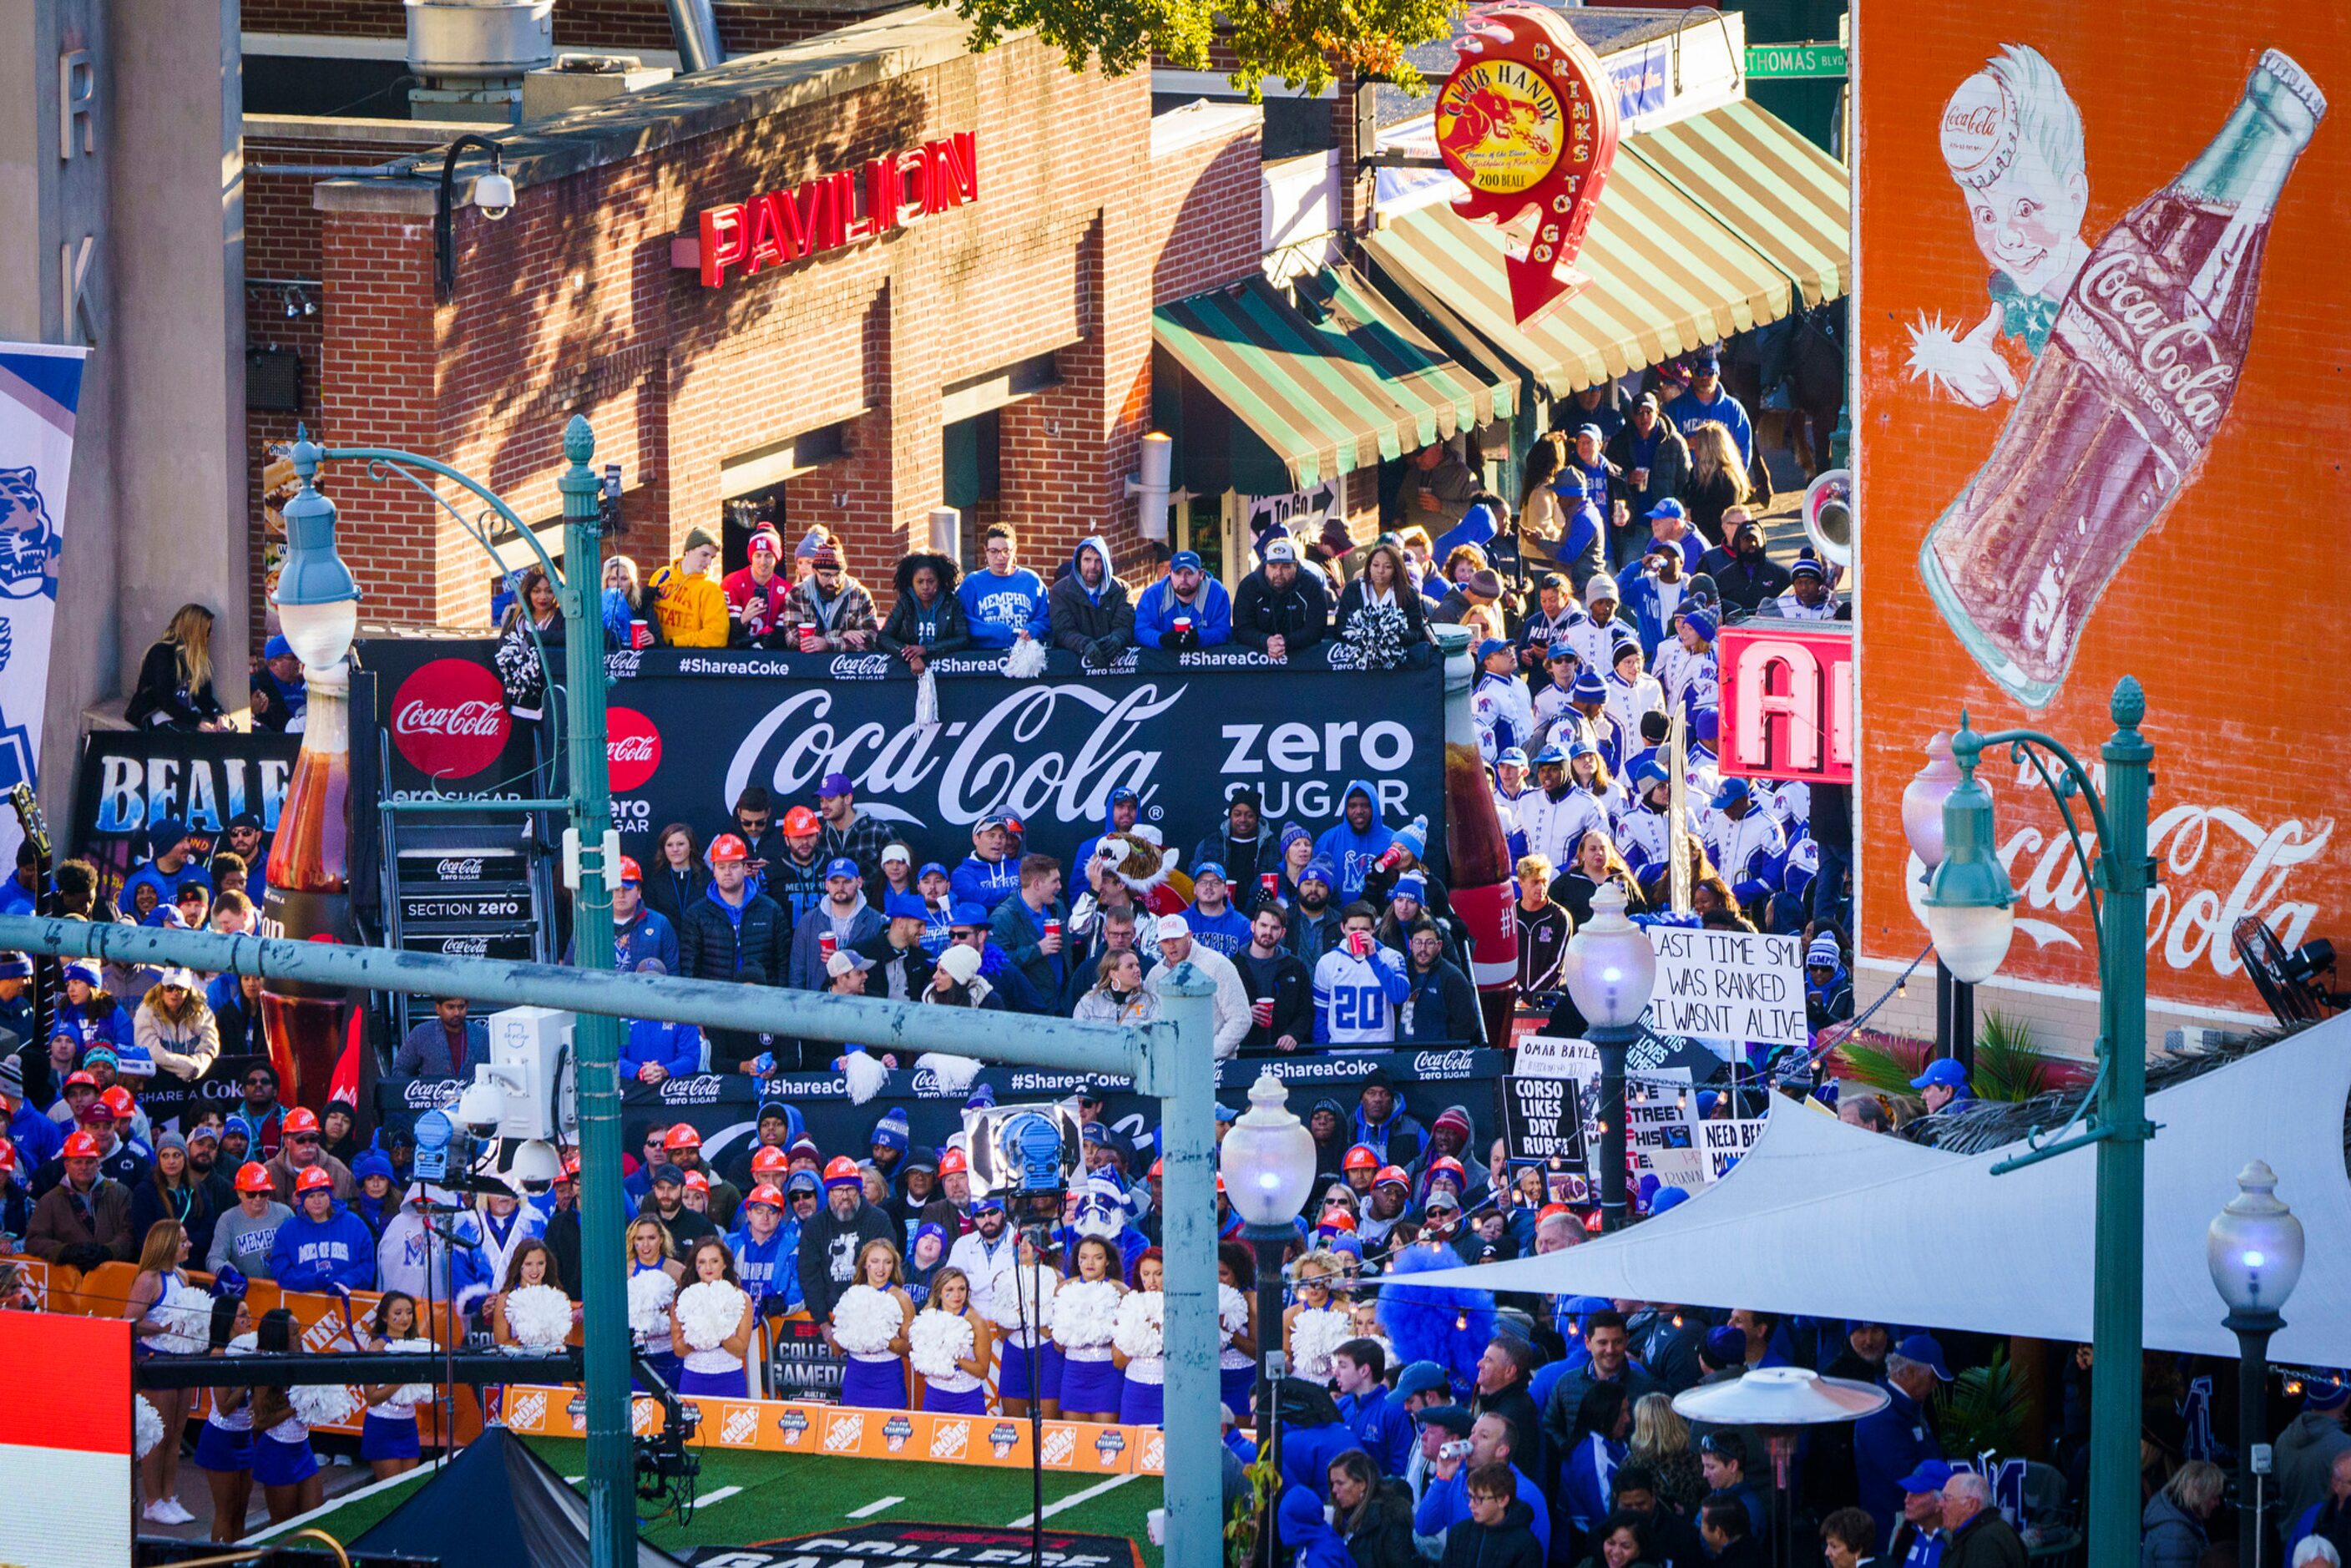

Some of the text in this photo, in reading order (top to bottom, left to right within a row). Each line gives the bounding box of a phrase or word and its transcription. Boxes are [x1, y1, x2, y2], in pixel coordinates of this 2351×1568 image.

[1746, 52, 1844, 72] THOMAS BLVD
[1444, 68, 1490, 117] CLUB
[1498, 64, 1560, 122] HANDY
[1534, 43, 1591, 162] DRINKS
[1479, 174, 1526, 188] 200 BEALE
[700, 130, 978, 288] PAVILION
[2079, 251, 2233, 428] Coca-Cola
[978, 592, 1033, 616] MEMPHIS
[679, 658, 790, 675] #ShareaCoke
[829, 654, 892, 675] Coca-Cola
[1332, 662, 1353, 670] zero
[397, 700, 504, 736] Coca-Cola
[725, 682, 1189, 829] Coca-Cola
[1220, 720, 1414, 773] zero
[610, 800, 651, 818] ero
[614, 820, 650, 833] GAR
[437, 858, 485, 875] Coca-Cola
[408, 901, 519, 917] SECTION zero
[1648, 932, 1803, 969] LAST TIME SMU
[1666, 966, 1787, 1003] WAS RANKED
[1334, 985, 1383, 1030] 20
[1652, 998, 1807, 1041] I WASNT ALIVE
[1524, 1043, 1599, 1060] OMAR BAYLE
[1636, 1034, 1669, 1065] LOVES
[1261, 1060, 1378, 1080] #ShareaCoke
[1413, 1050, 1475, 1072] Coca-Cola
[1419, 1070, 1470, 1080] zero SUGAR
[138, 1090, 199, 1103] SHARE A
[660, 1075, 724, 1098] Coca-Cola
[1515, 1080, 1564, 1098] CORSO
[409, 1100, 431, 1109] zero
[665, 1096, 717, 1105] zero SUGAR
[1521, 1100, 1563, 1118] LIKES
[1529, 1119, 1559, 1136] DRY
[1706, 1124, 1737, 1147] NEED
[1523, 1136, 1570, 1156] RUBS!
[509, 1390, 547, 1429] HOME
[721, 1405, 758, 1443] HOME
[825, 1414, 863, 1450] HOME
[931, 1420, 970, 1457] HOME
